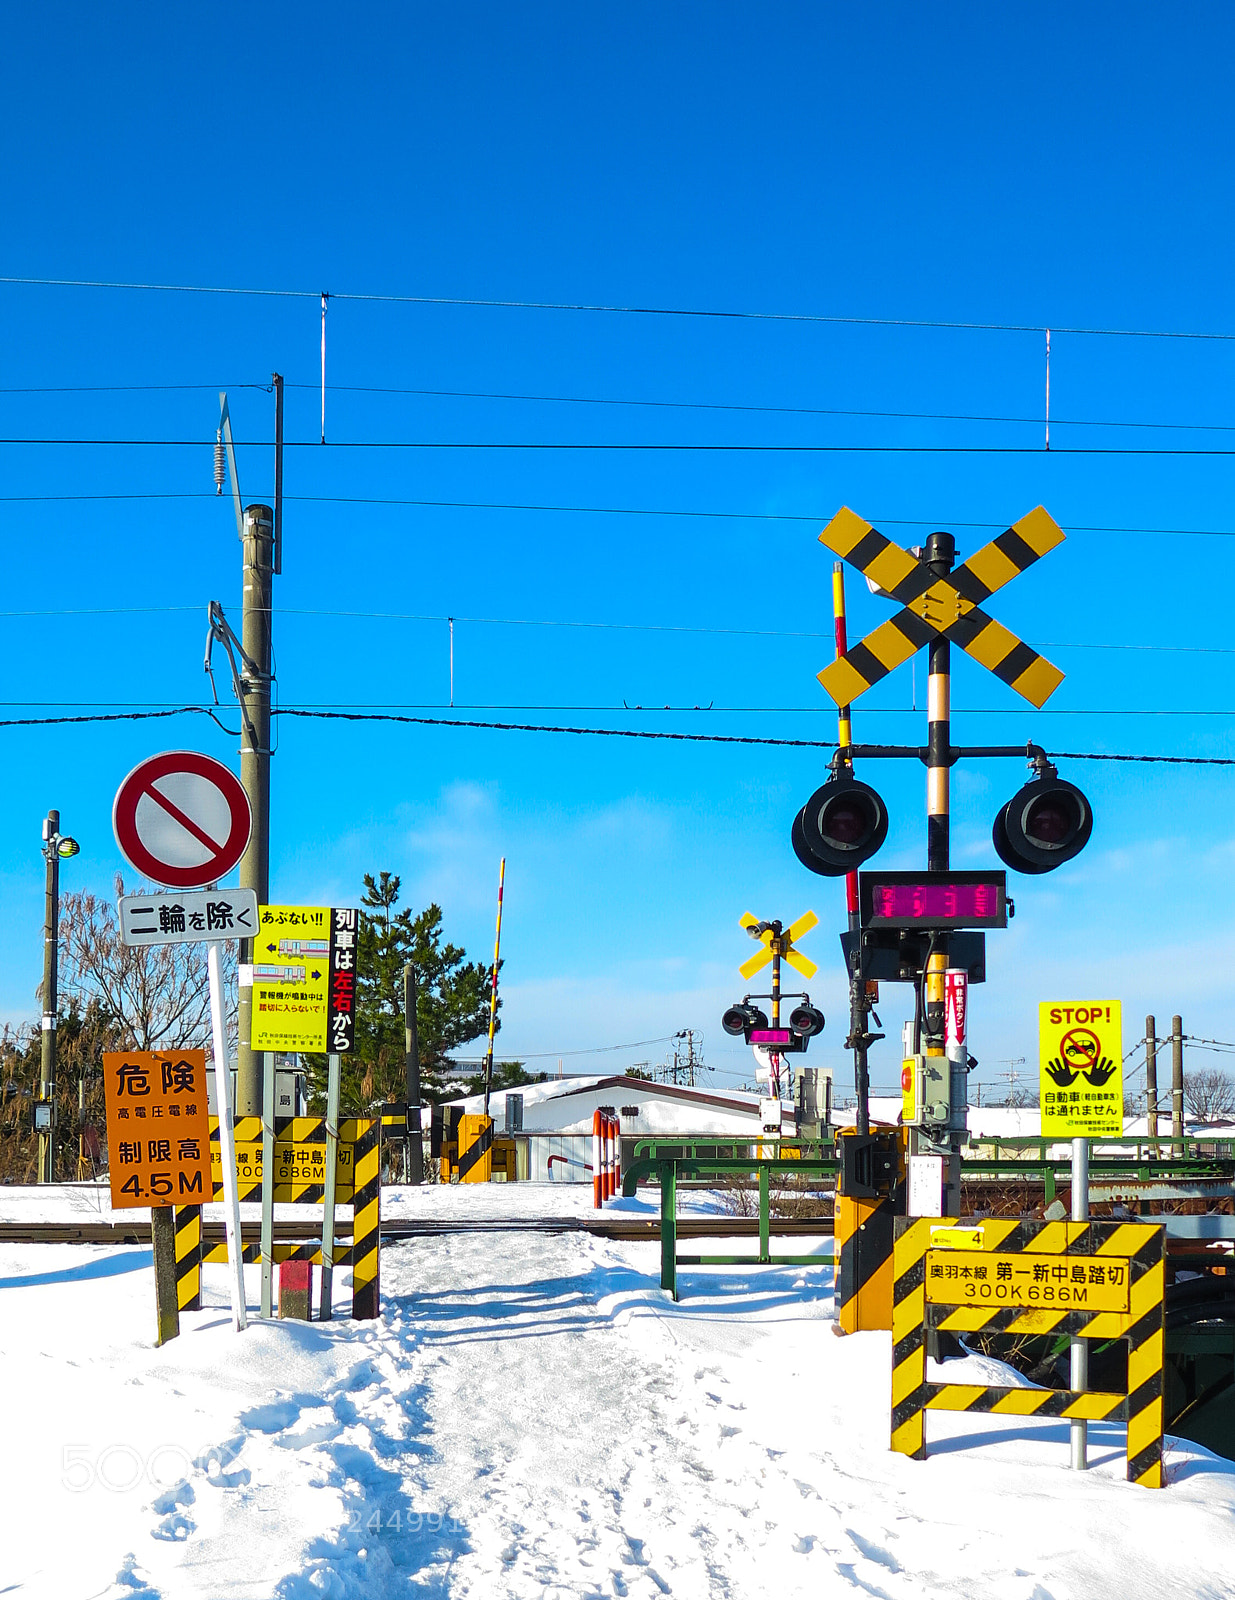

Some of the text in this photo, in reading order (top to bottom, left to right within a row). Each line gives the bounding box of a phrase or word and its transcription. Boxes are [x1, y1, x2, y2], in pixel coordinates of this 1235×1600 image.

[130, 901, 252, 934] 二輪を除く
[262, 911, 323, 926] あぶない!!
[332, 908, 355, 1051] 列車は左右から
[1050, 1007, 1110, 1024] STOP!
[116, 1060, 196, 1096] 危険
[117, 1103, 198, 1120] 高電圧電線
[1045, 1105, 1117, 1116] は通れません
[119, 1138, 200, 1164] 制限高
[972, 1231, 981, 1244] 4
[930, 1261, 1125, 1286] 奥羽本線 第一新中島踏切
